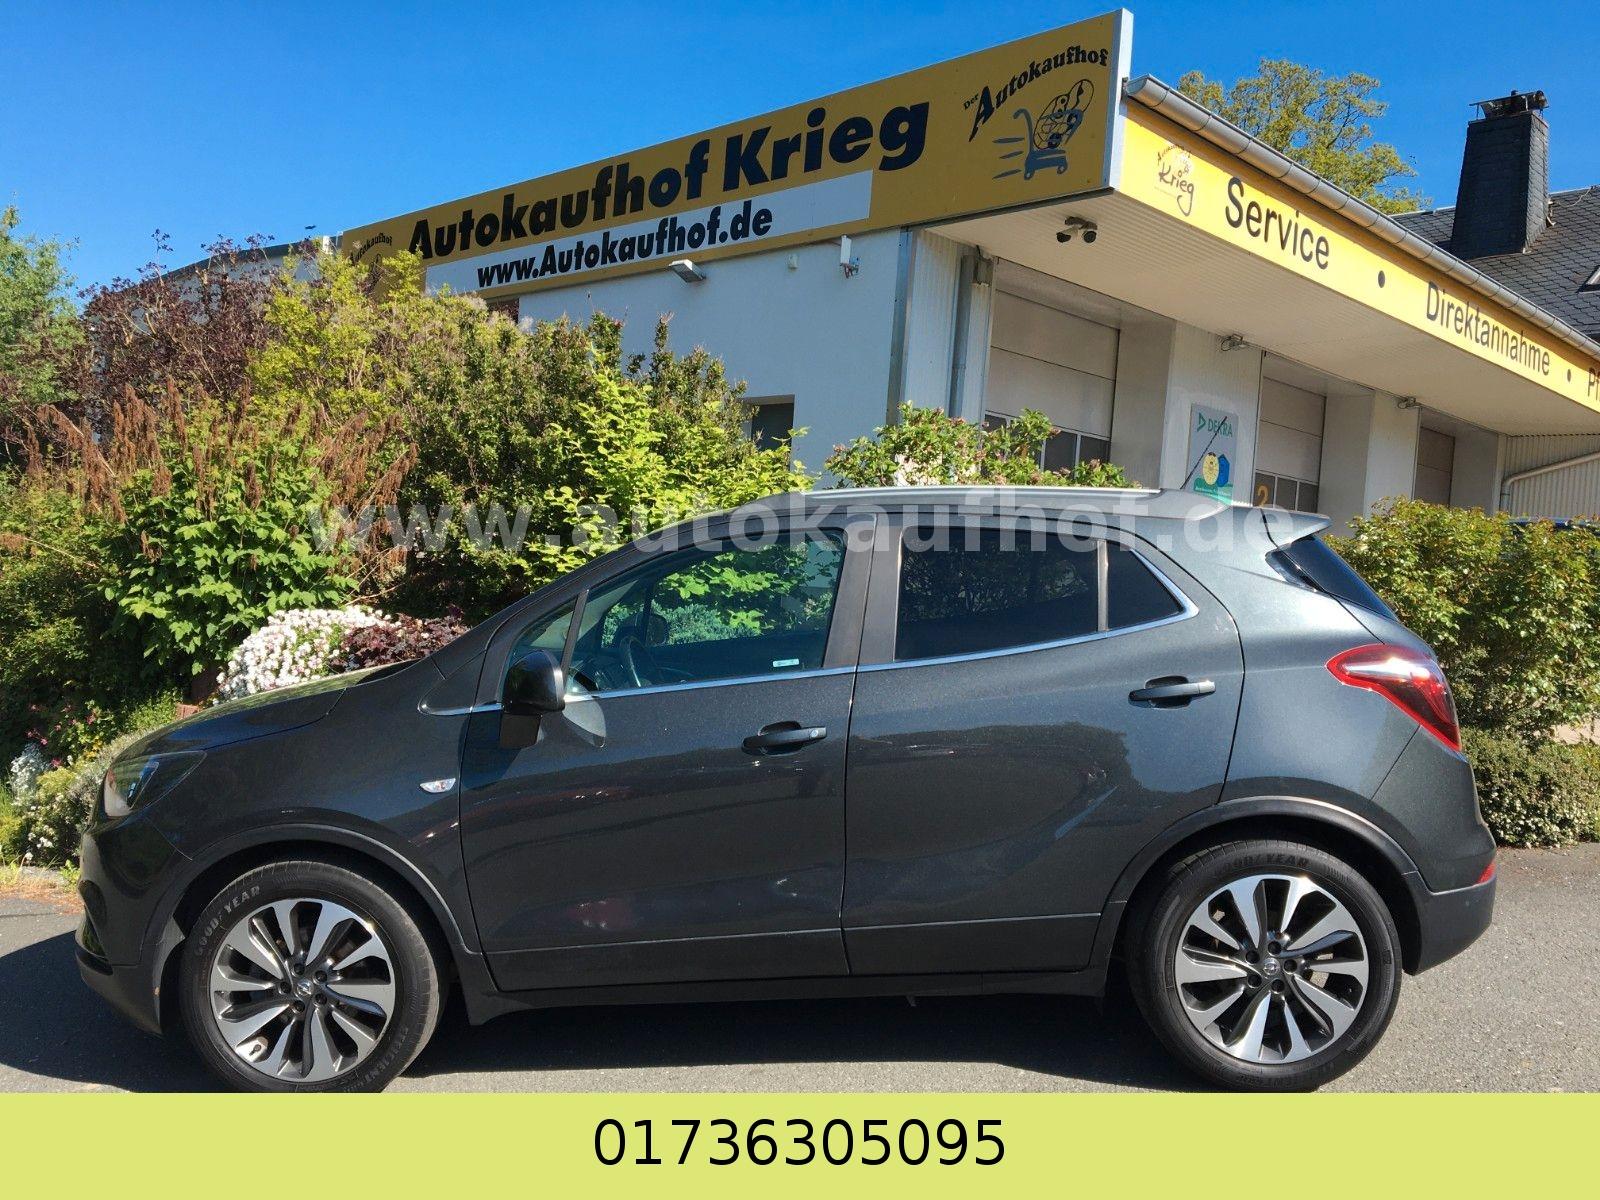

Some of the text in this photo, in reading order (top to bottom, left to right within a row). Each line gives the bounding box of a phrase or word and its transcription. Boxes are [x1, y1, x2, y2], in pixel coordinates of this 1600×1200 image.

[963, 45, 1109, 142] Der Autokaufhof
[409, 101, 930, 259] Autokaufhof Krieg
[1158, 162, 1194, 217] Krieg
[477, 200, 773, 288] www.Autokaufhof.de
[1225, 176, 1330, 270] Service
[1426, 281, 1550, 376] Direktannahme
